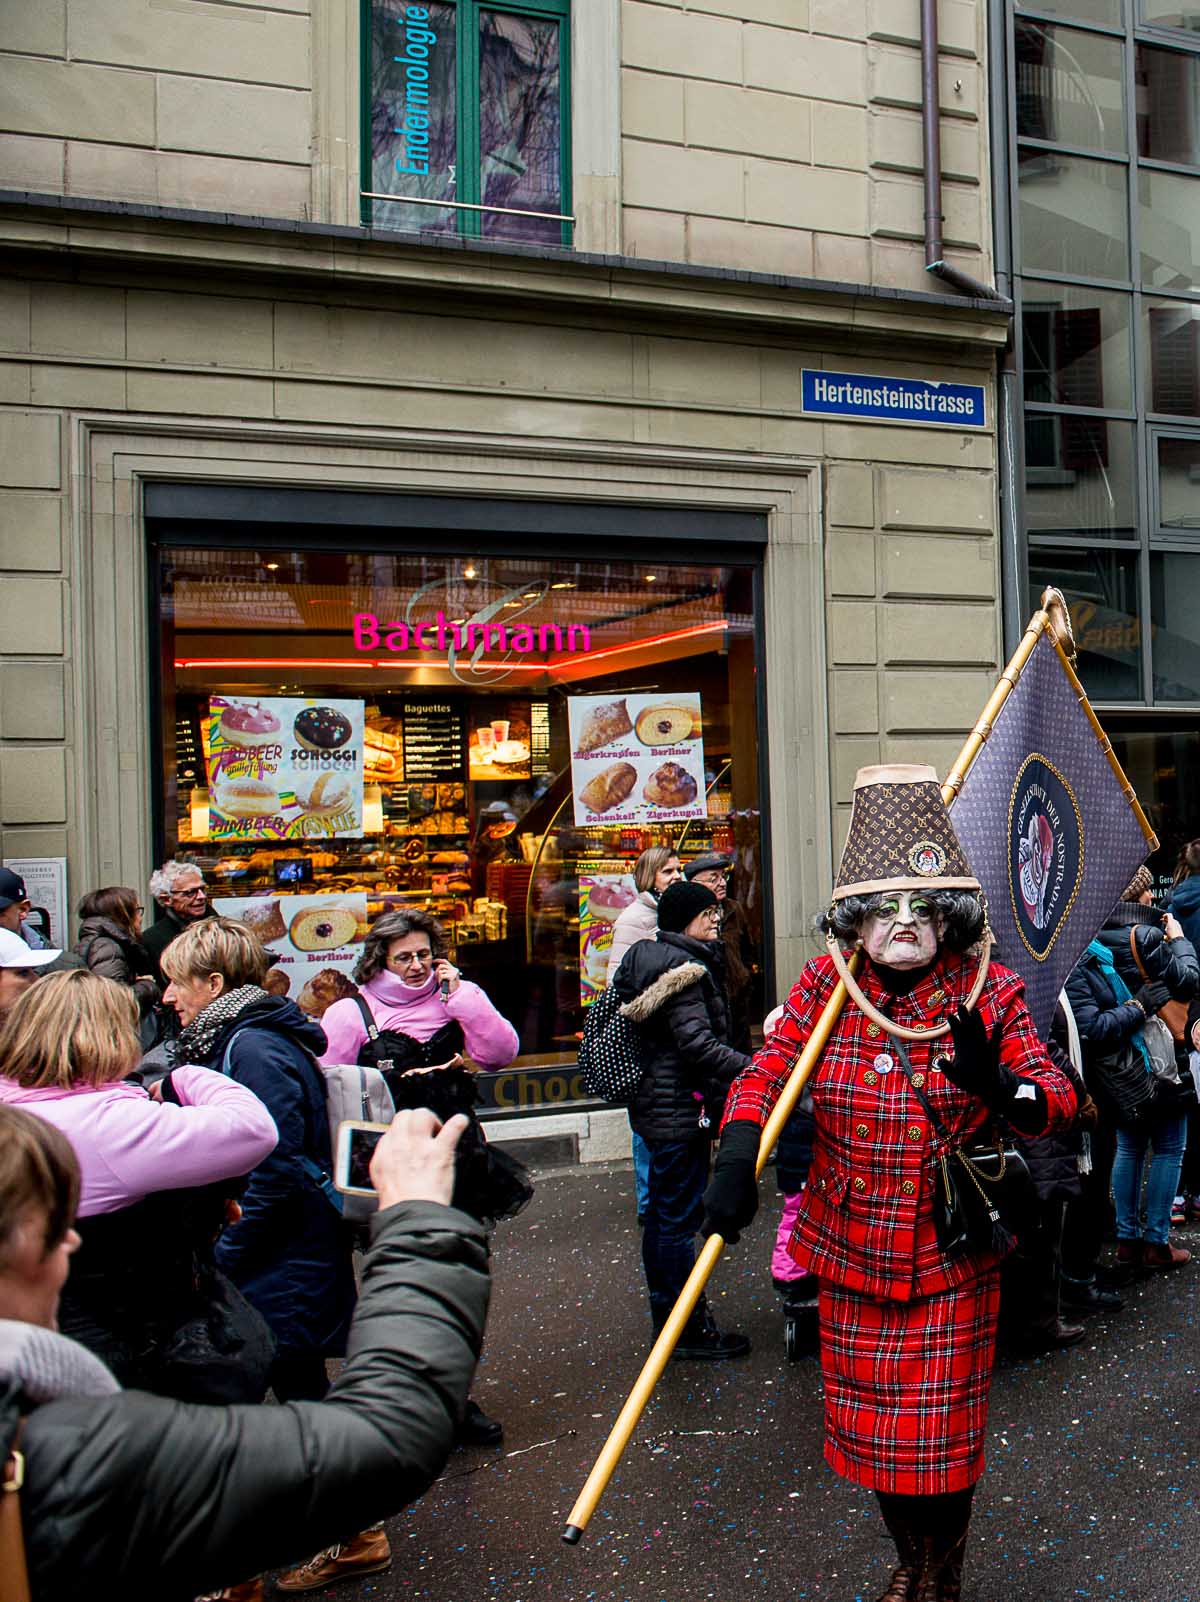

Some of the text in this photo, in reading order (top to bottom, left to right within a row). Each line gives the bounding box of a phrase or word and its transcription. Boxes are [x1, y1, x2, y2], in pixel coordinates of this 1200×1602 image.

[394, 5, 436, 175] Endermologie
[814, 378, 974, 415] Hertensteinstrasse
[353, 610, 591, 653] Bachmann
[404, 704, 451, 715] Baguettes
[573, 748, 640, 760] Zigerkrapfen
[651, 748, 691, 757] Berliner
[1046, 800, 1060, 829] DER
[307, 952, 355, 963] Berliner
